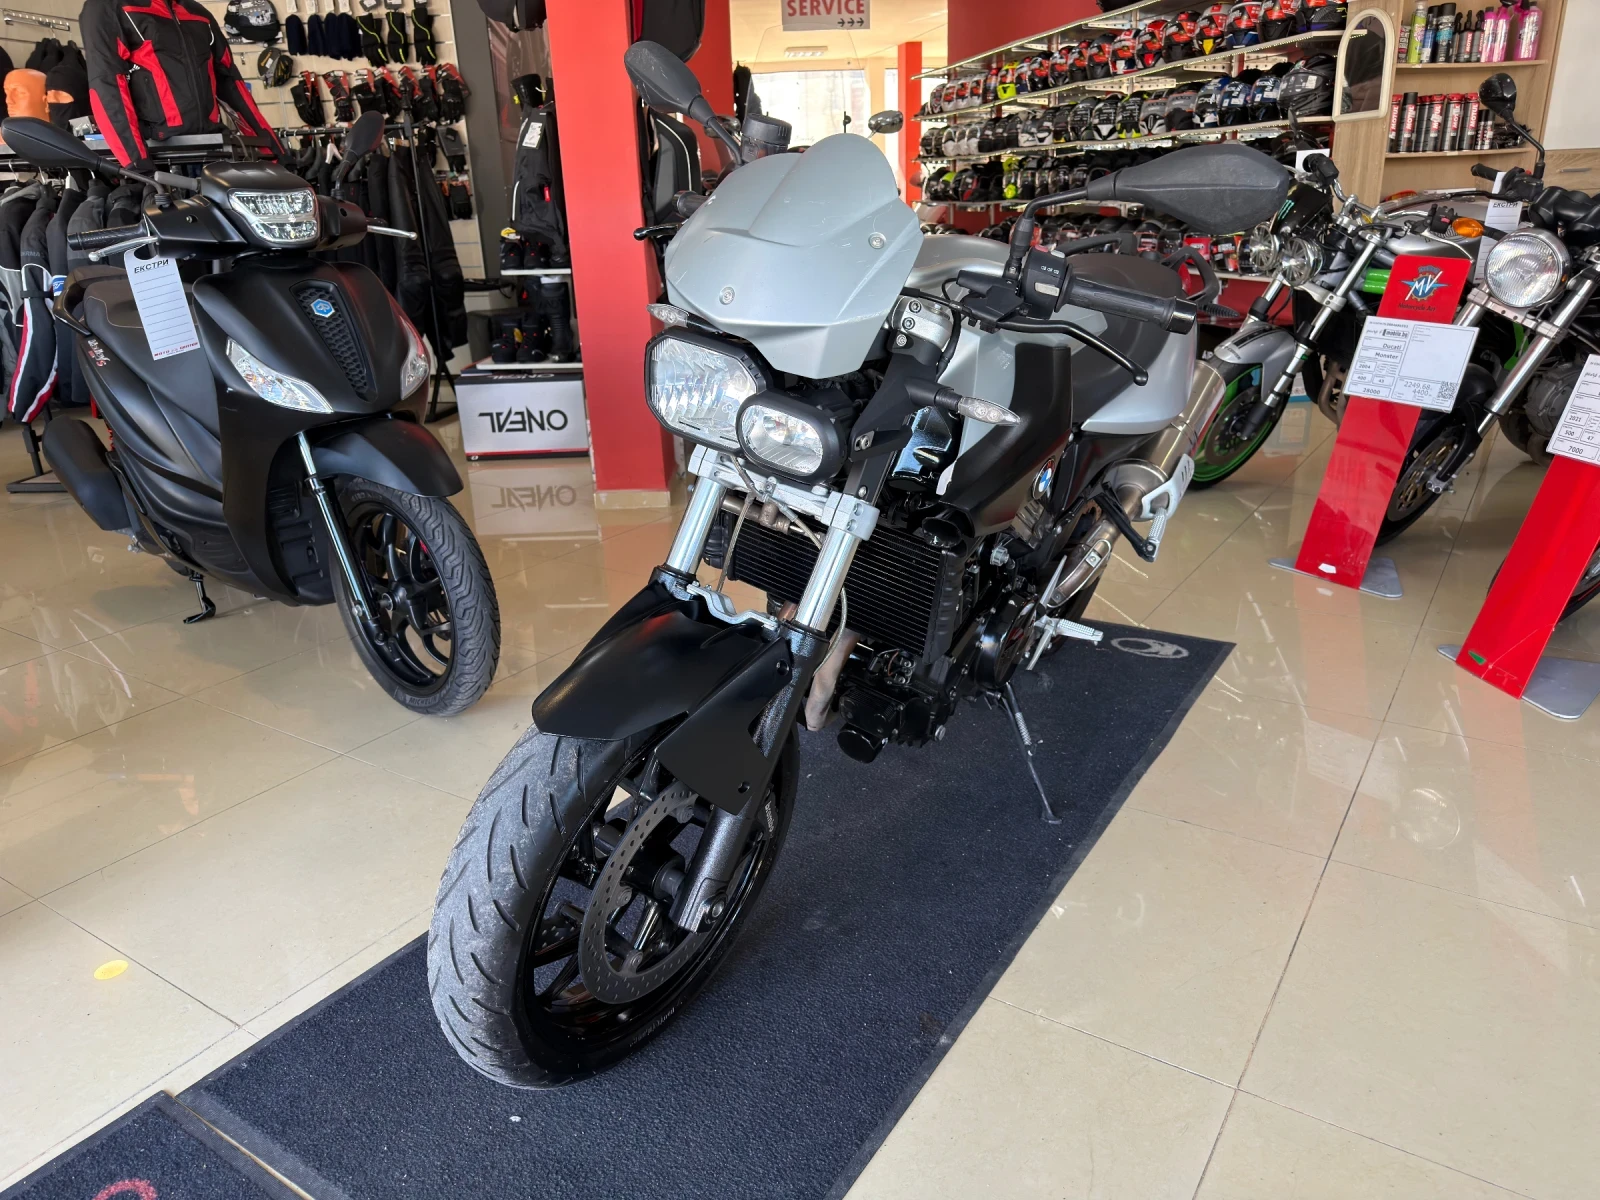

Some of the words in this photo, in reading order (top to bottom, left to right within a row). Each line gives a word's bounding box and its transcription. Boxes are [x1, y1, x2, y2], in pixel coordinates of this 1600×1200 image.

[787, 0, 865, 17] SERVICE
[1390, 105, 1399, 129] MOTUL
[1470, 103, 1479, 128] MOTUL
[133, 258, 170, 274] ЕКСТРИ
[1397, 302, 1426, 312] Motorcycle
[1374, 352, 1399, 360] Monster
[1568, 414, 1582, 423] 2021
[1564, 429, 1575, 437] 500
[1567, 445, 1584, 455] 7000
